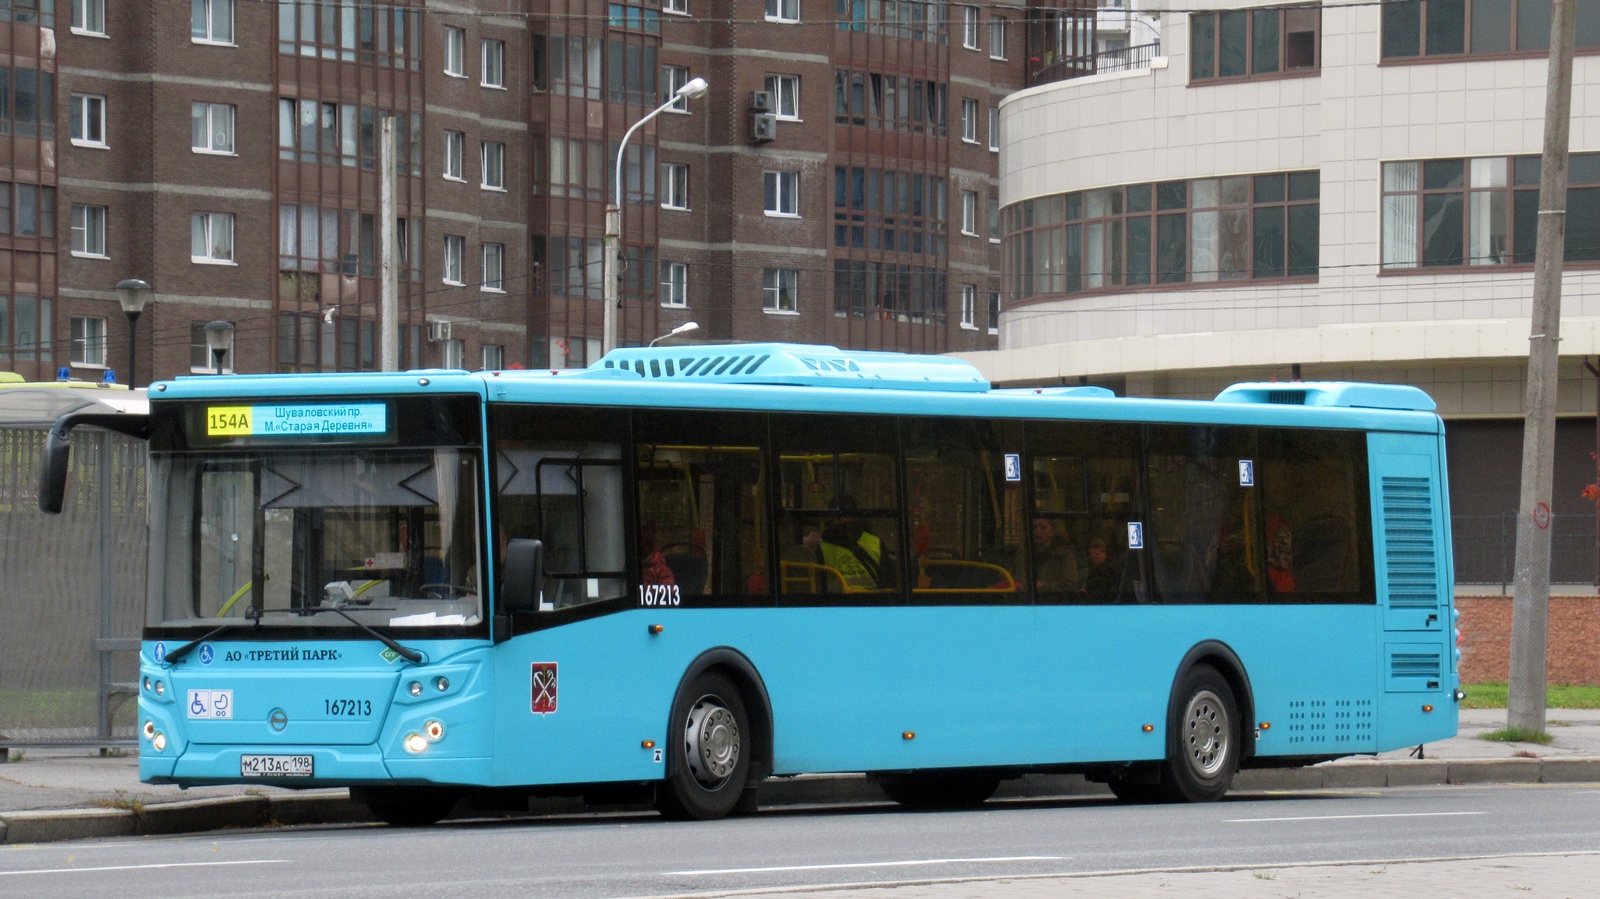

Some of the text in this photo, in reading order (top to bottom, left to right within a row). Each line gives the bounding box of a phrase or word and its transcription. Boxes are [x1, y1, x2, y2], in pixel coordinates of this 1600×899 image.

[275, 405, 347, 420] Шуваловский
[321, 419, 373, 433] Деревня»
[639, 584, 681, 606] 167213
[225, 646, 343, 661] АО «ТРЕТИЙ ПАРК»
[325, 699, 372, 716] 167213
